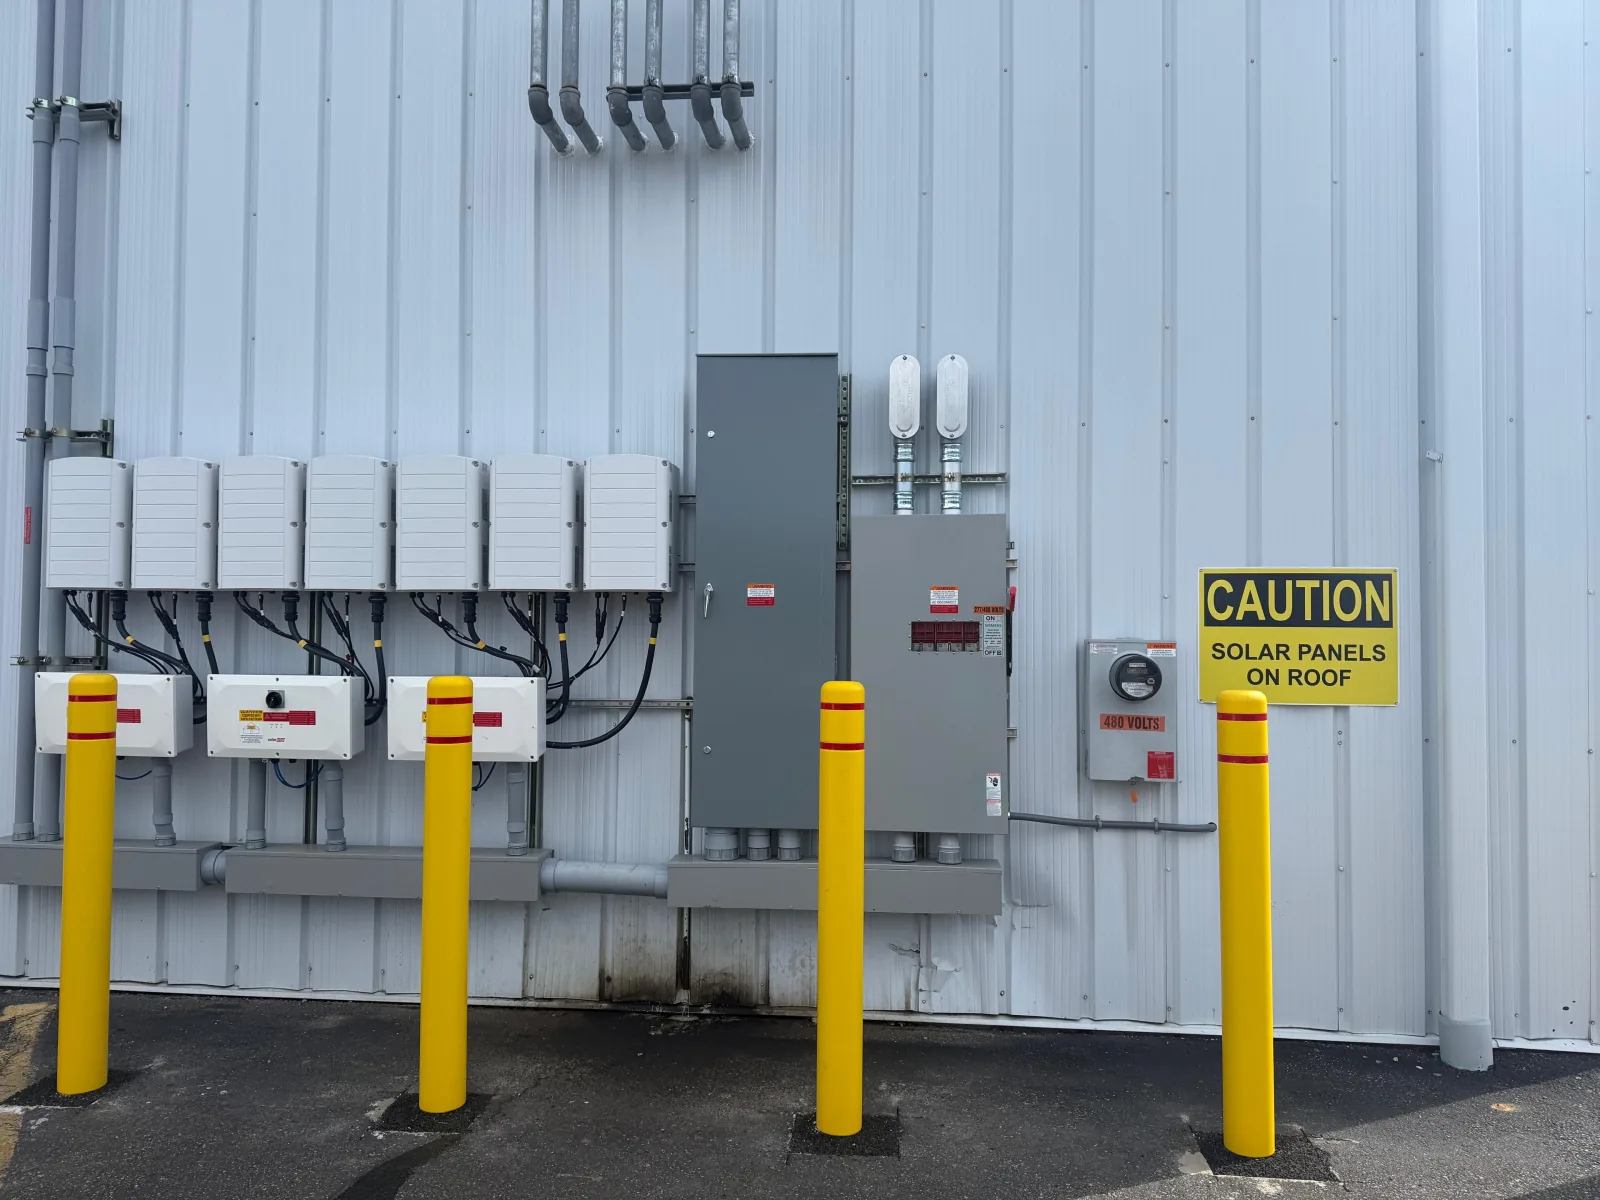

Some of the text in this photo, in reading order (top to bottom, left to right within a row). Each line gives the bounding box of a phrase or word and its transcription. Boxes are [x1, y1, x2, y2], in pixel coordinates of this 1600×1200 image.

[1207, 579, 1390, 622] CAUTION
[1211, 642, 1386, 662] SOLAR PANELS
[1246, 667, 1352, 687] ON ROOF
[1103, 715, 1160, 730] 480 VOLTS
